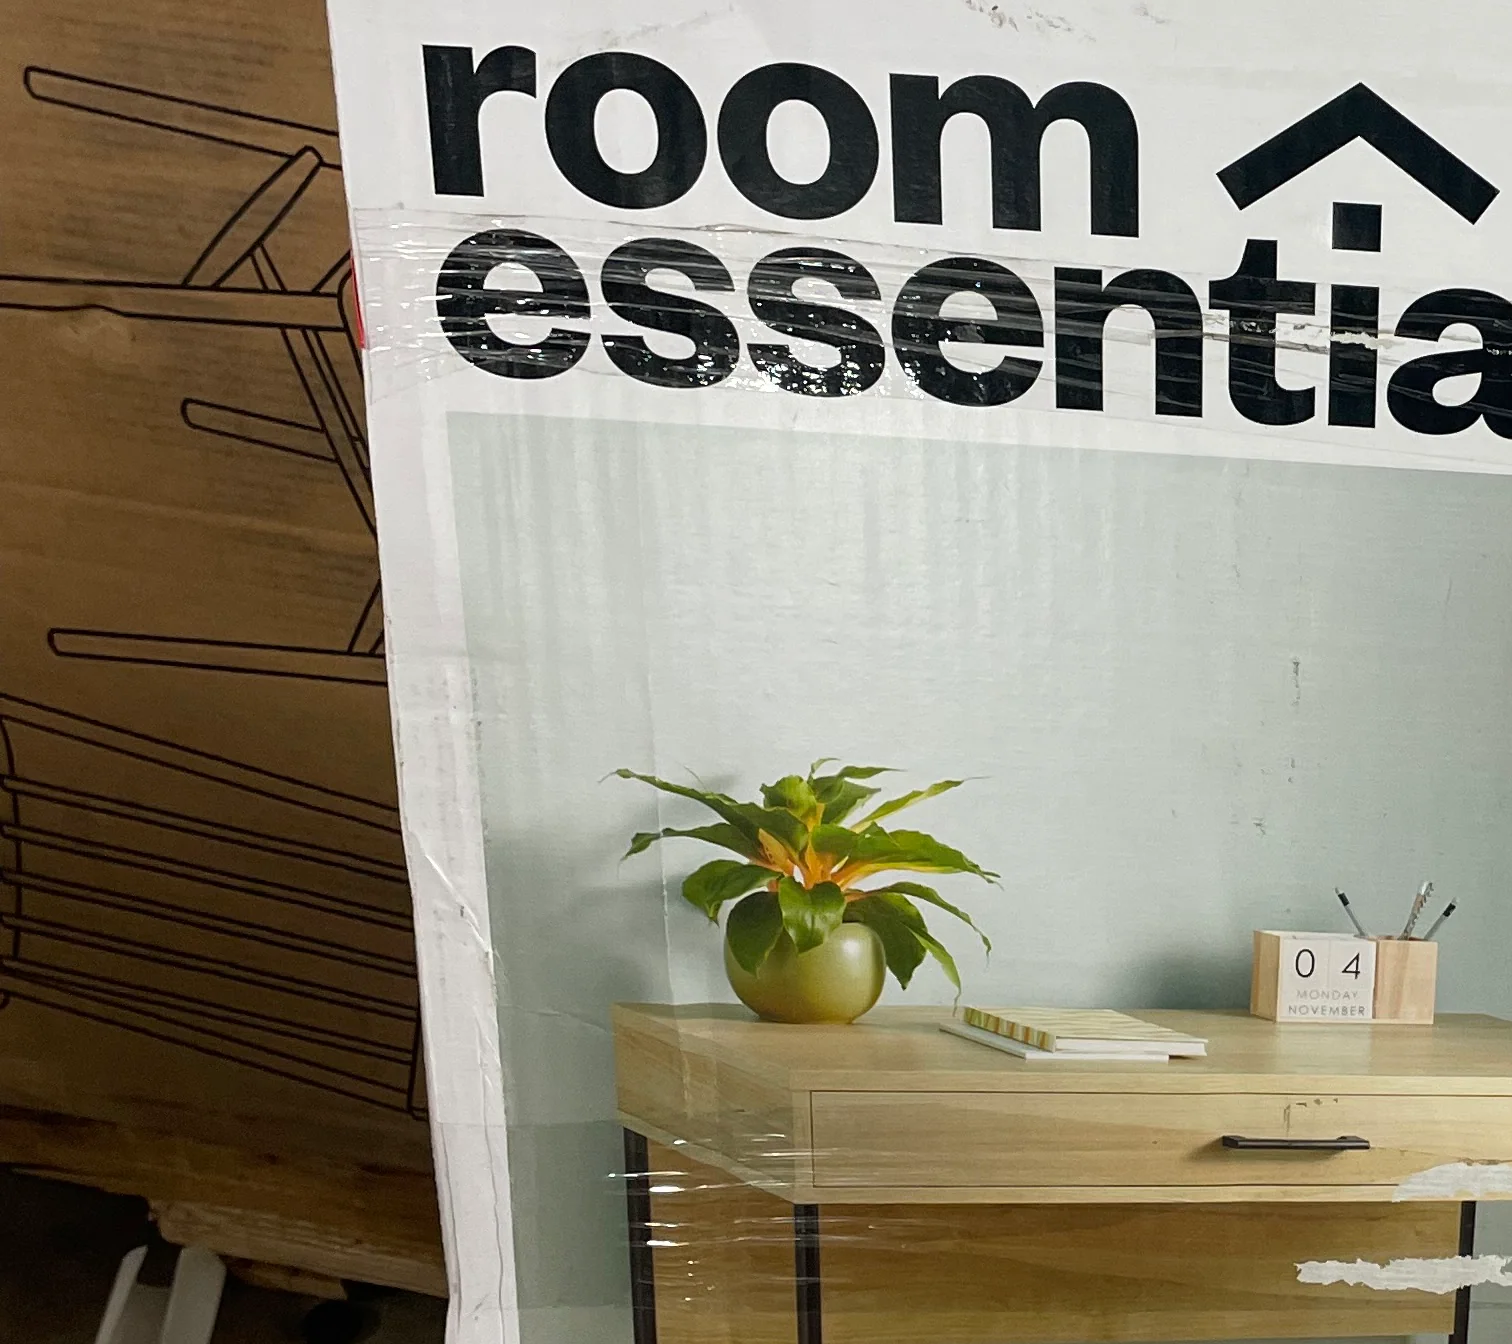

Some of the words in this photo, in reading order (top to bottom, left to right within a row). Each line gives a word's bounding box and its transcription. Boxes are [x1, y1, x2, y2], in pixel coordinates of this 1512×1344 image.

[421, 43, 1139, 238] room
[1296, 989, 1359, 1002] MONDAY
[1288, 1004, 1365, 1017] NOVEMBER
